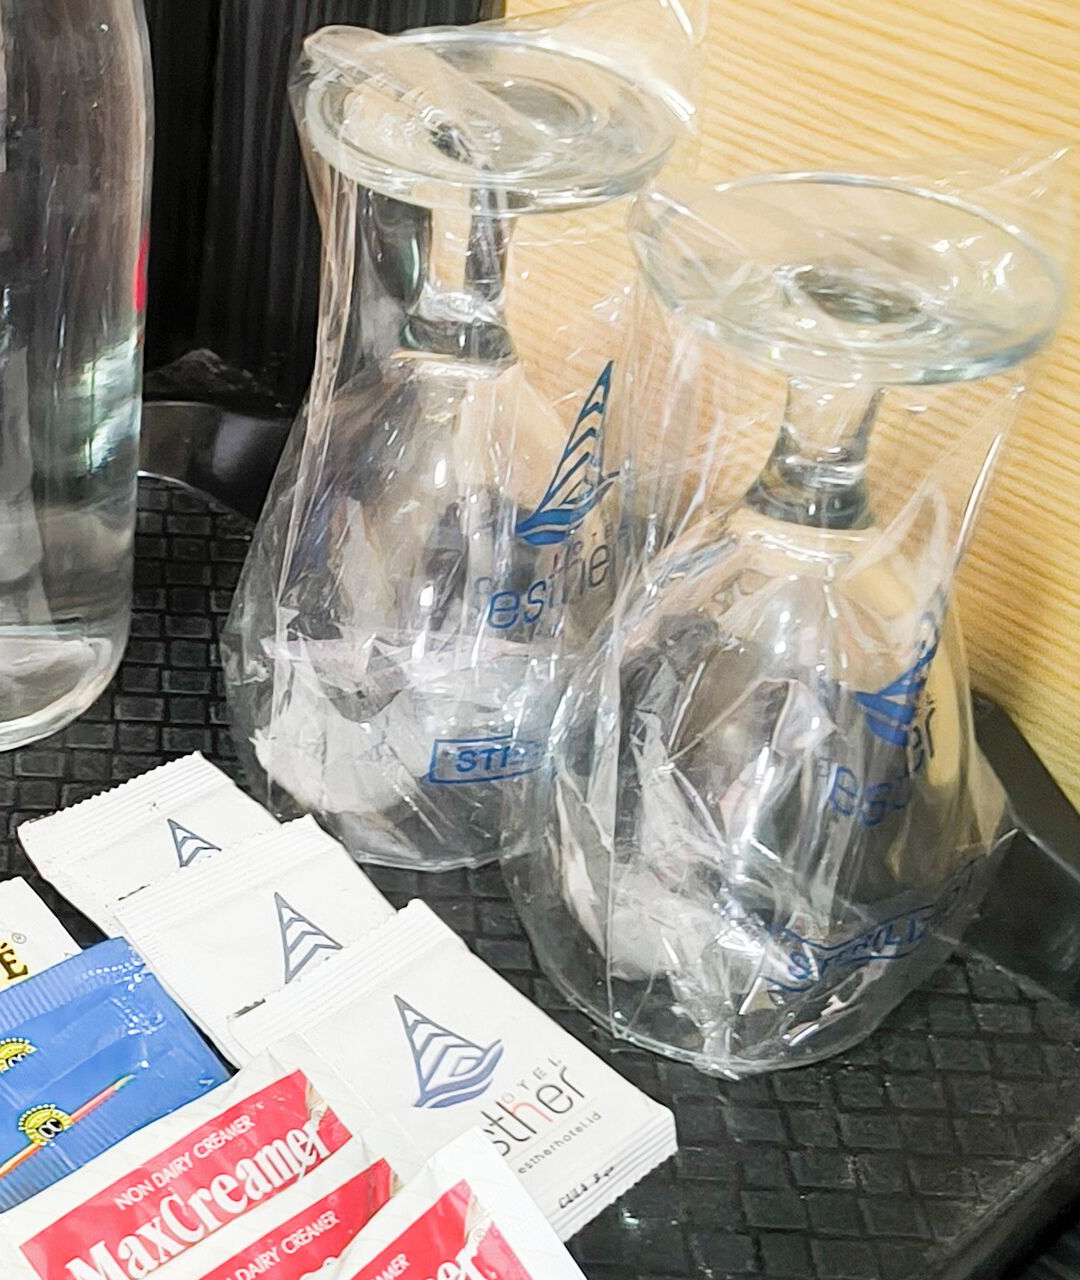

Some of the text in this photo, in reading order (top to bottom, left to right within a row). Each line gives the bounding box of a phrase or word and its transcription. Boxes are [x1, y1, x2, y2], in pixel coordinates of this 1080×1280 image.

[480, 1066, 585, 1157] sther
[517, 1112, 602, 1174] estherhotel.id
[114, 1114, 256, 1210] NON DAIRY CREAMER
[282, 1211, 340, 1254] CREAMER
